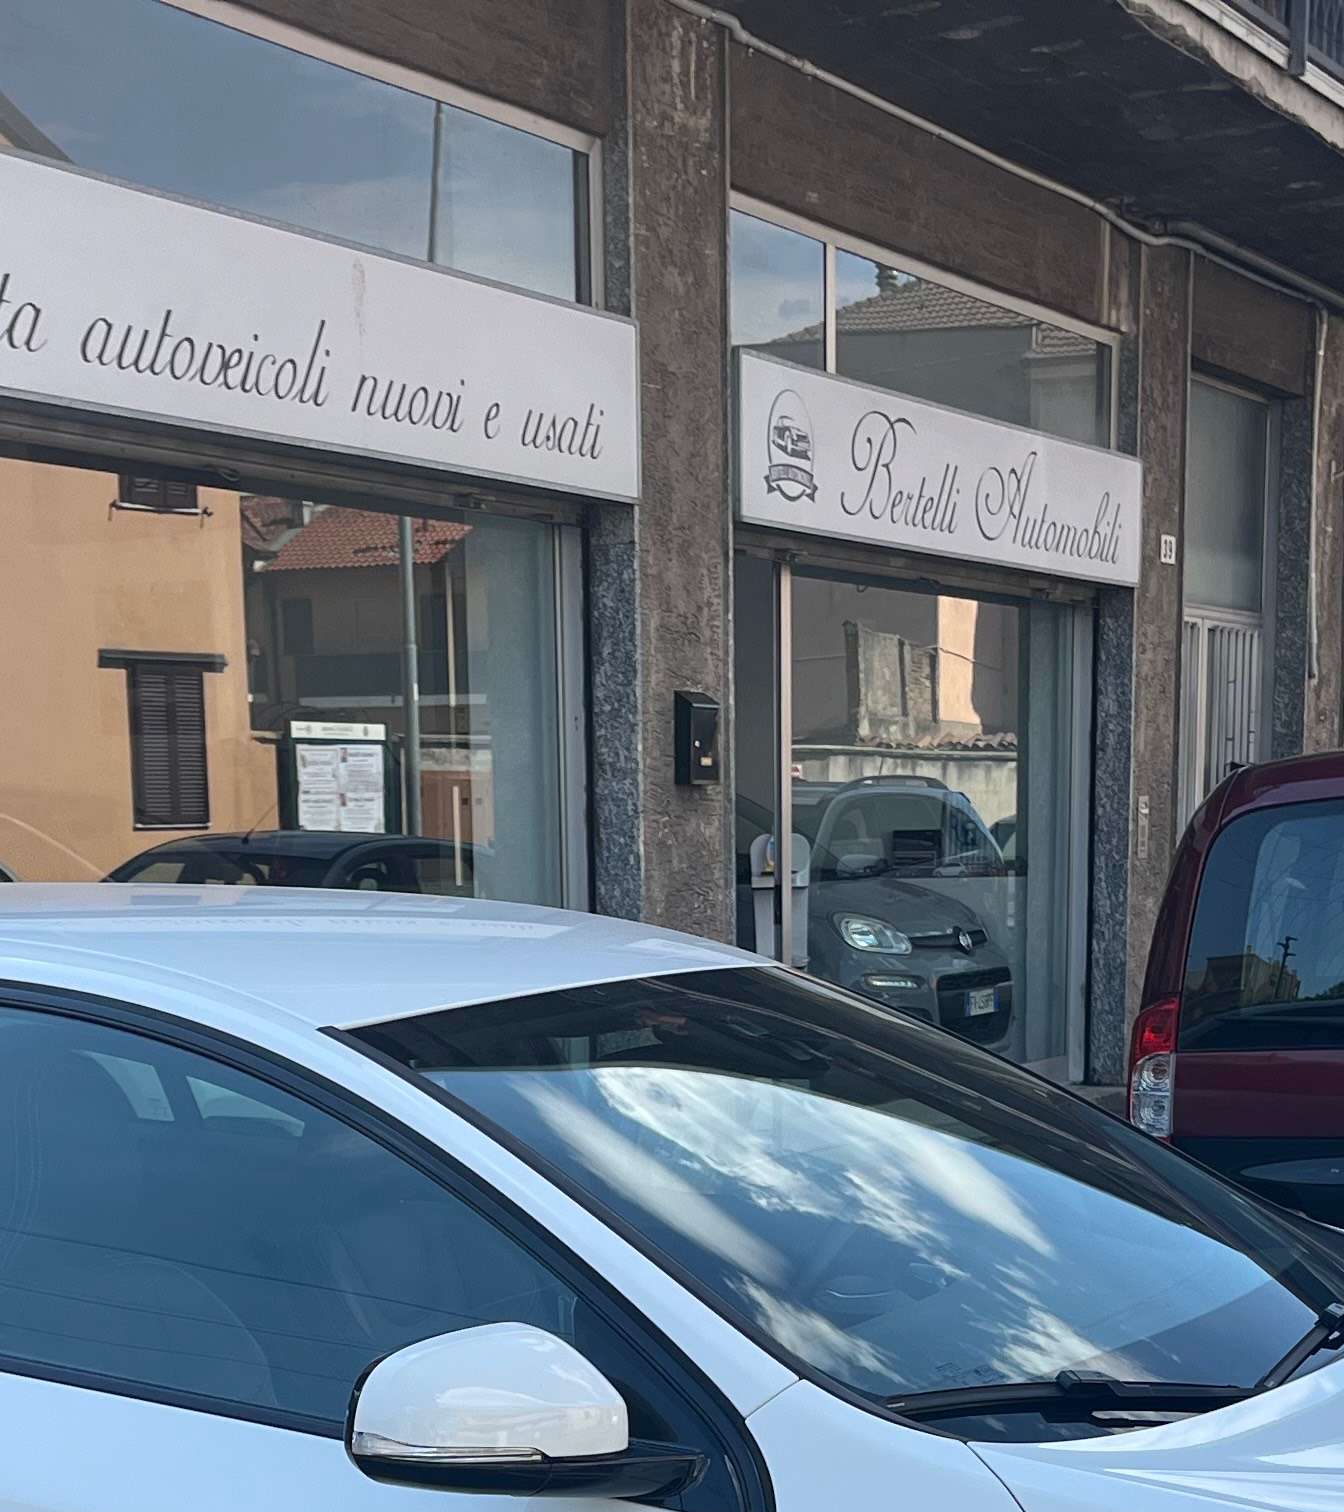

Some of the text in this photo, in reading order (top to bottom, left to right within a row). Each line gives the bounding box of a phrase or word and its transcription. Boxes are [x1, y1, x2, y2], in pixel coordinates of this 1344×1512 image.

[80, 309, 331, 407] autoveicoli
[351, 374, 465, 433] nuovi
[483, 400, 502, 440] e
[521, 403, 605, 460] usati
[840, 410, 1122, 564] Bertelli Automobili
